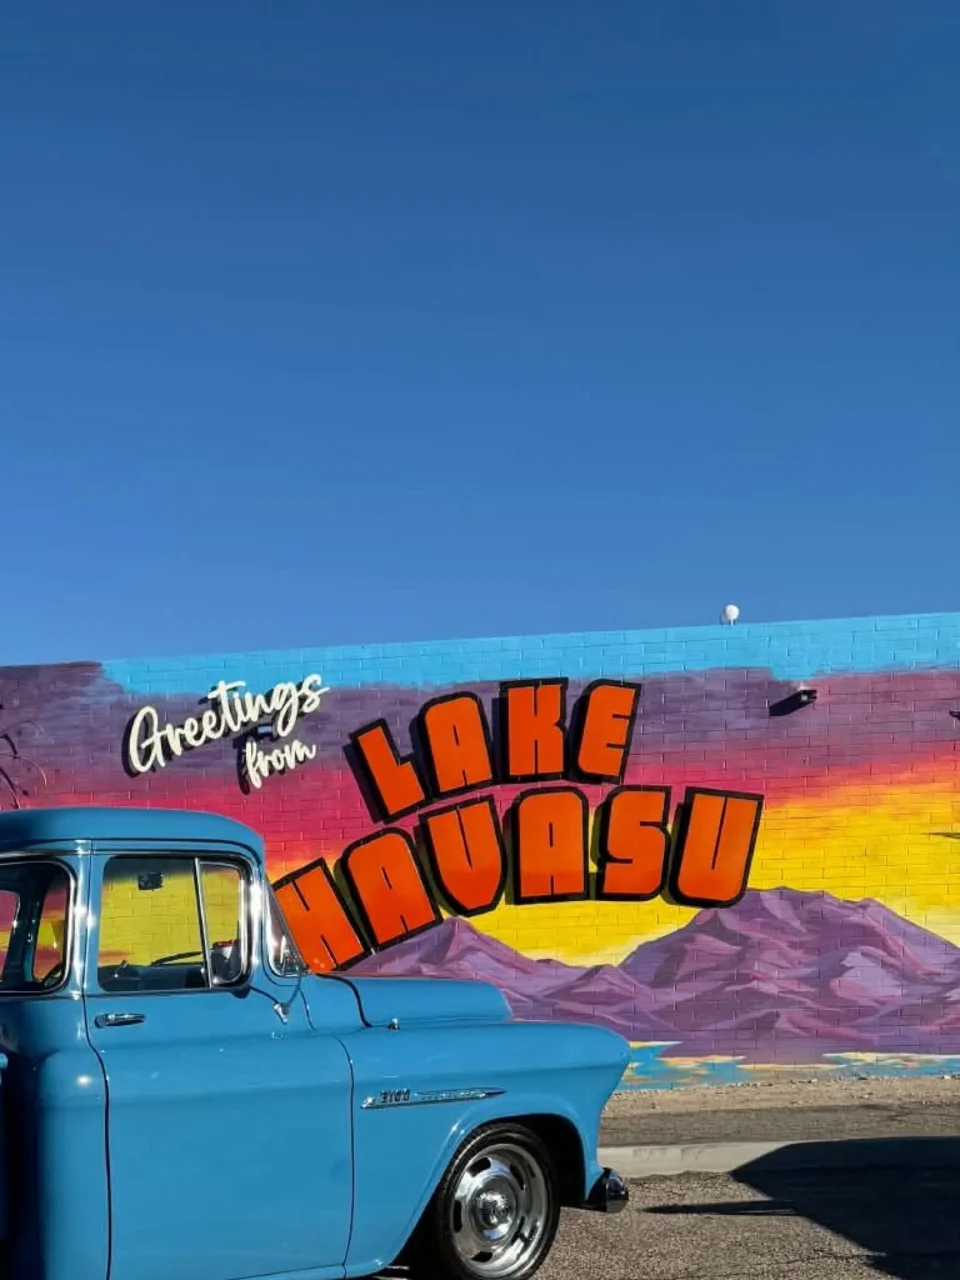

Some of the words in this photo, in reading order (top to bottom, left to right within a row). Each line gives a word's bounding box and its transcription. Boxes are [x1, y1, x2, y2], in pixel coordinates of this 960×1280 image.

[129, 674, 330, 773] Greetings
[245, 739, 316, 789] from
[350, 677, 641, 824] LAKE
[270, 785, 764, 974] HAVASU
